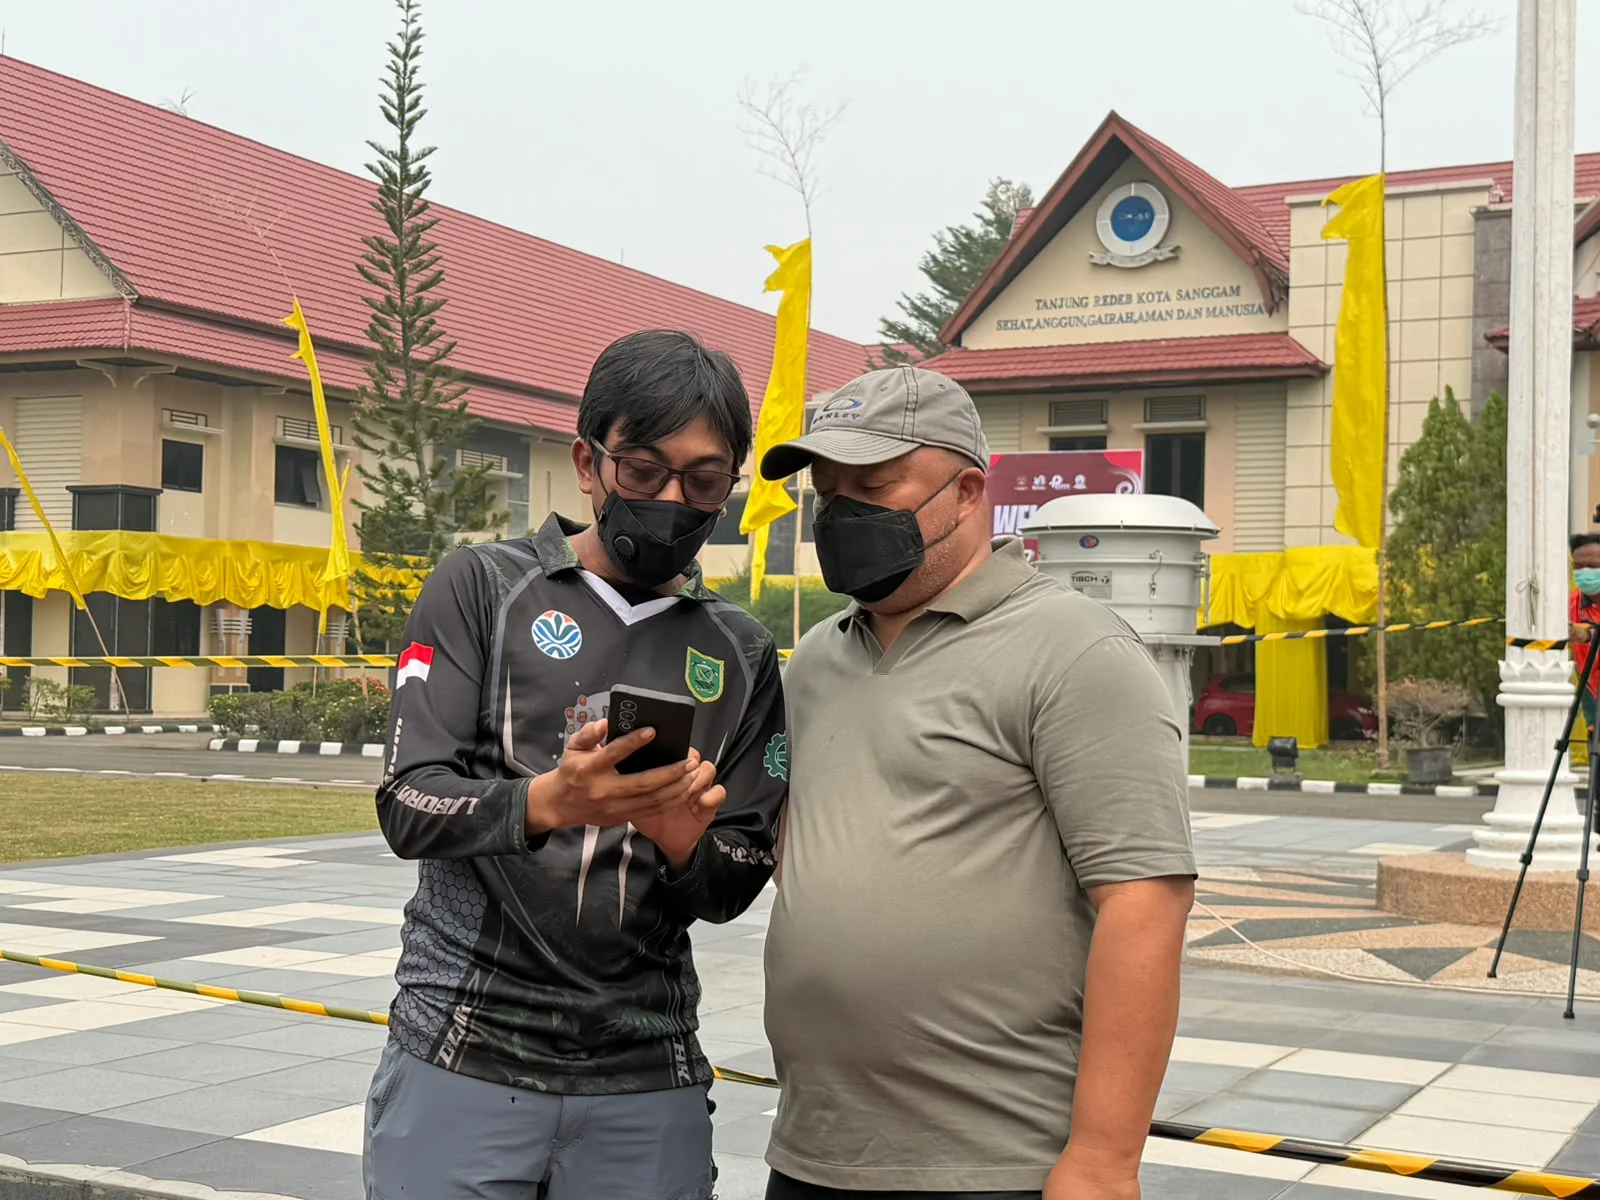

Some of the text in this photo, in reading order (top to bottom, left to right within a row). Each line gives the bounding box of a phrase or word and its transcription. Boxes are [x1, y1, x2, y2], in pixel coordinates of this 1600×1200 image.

[1035, 296, 1089, 311] TANJUNG
[1136, 290, 1172, 304] KOTA
[1176, 284, 1241, 301] SANGGAM
[1177, 308, 1203, 320] DAN
